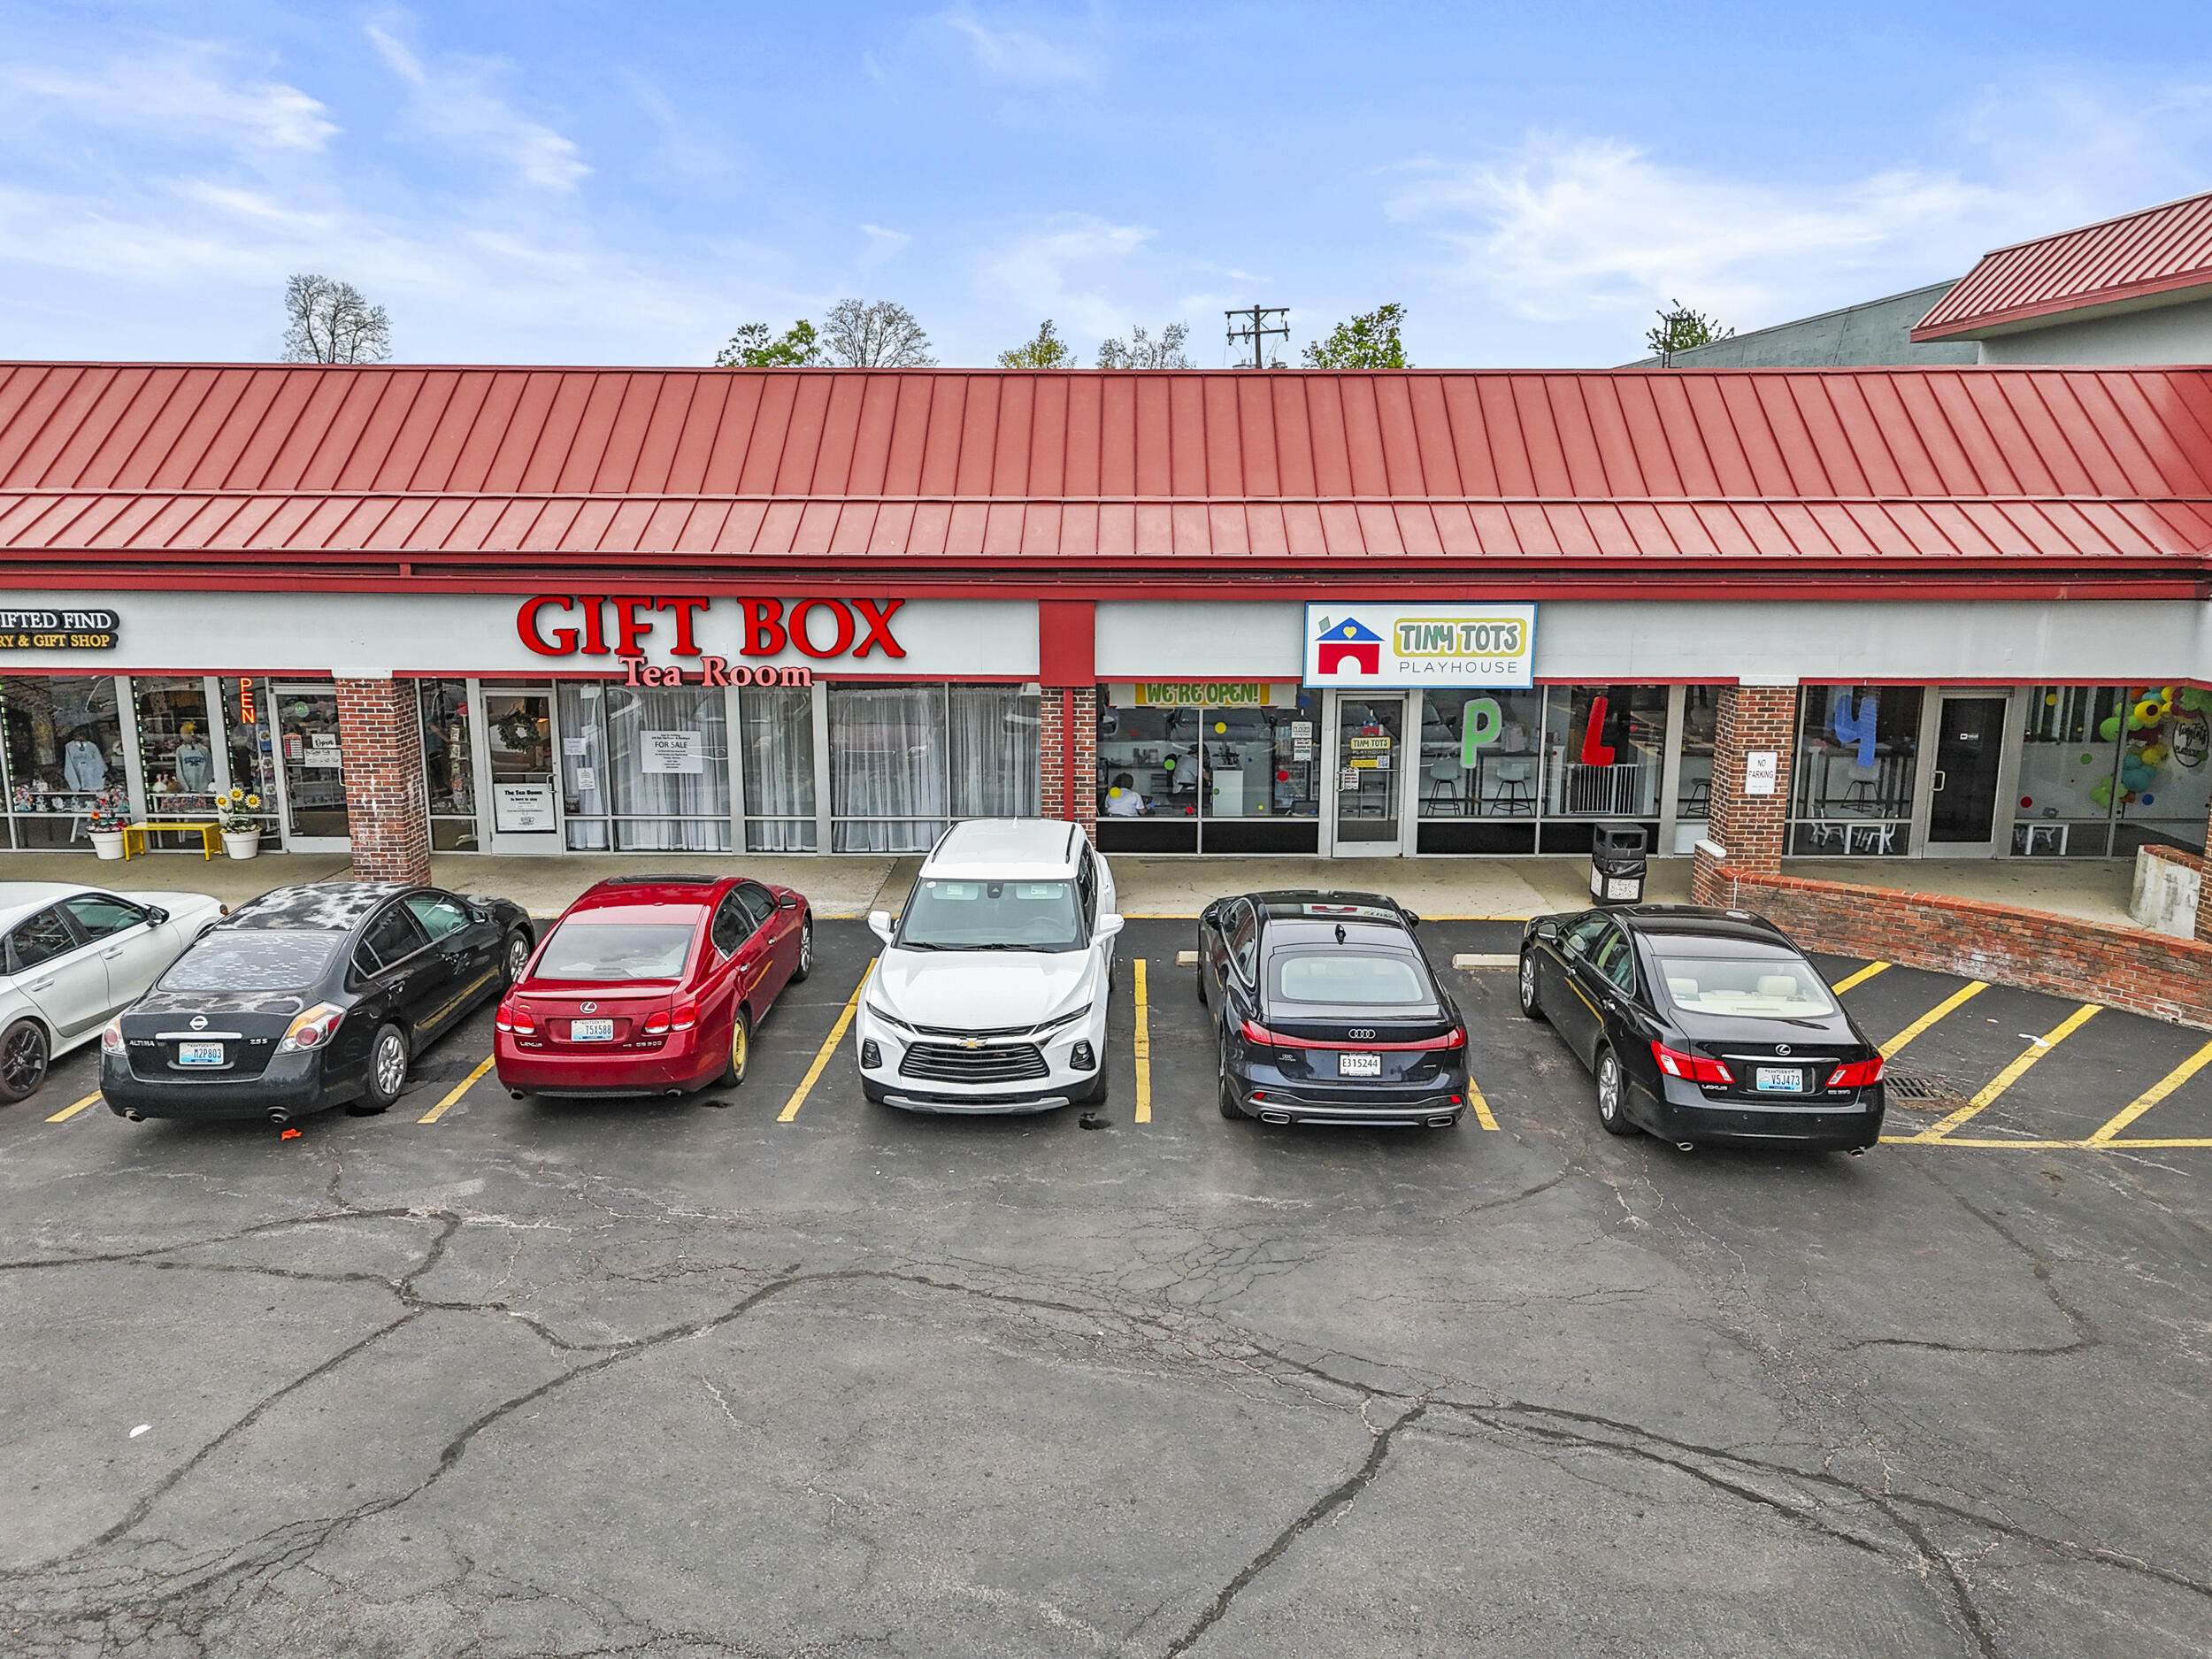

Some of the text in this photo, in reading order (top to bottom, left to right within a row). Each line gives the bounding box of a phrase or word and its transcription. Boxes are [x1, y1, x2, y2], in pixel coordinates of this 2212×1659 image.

[62, 612, 112, 629] FIND
[517, 595, 908, 658] GIFT BOX
[18, 634, 29, 647] &
[34, 634, 65, 647] GIFT
[71, 634, 111, 647] SHOP
[1399, 625, 1518, 651] TINY TOTS
[618, 656, 813, 687] Tea Room
[1399, 661, 1518, 673] PLAYHOUSE
[1205, 683, 1259, 703] OPEN!
[1757, 758, 1767, 767] NO
[1747, 770, 1774, 779] PARKING
[586, 1025, 611, 1035] T5X588
[194, 1048, 222, 1058] M2P803
[1342, 1058, 1378, 1068] E315244
[1771, 1074, 1801, 1086] V5J473
